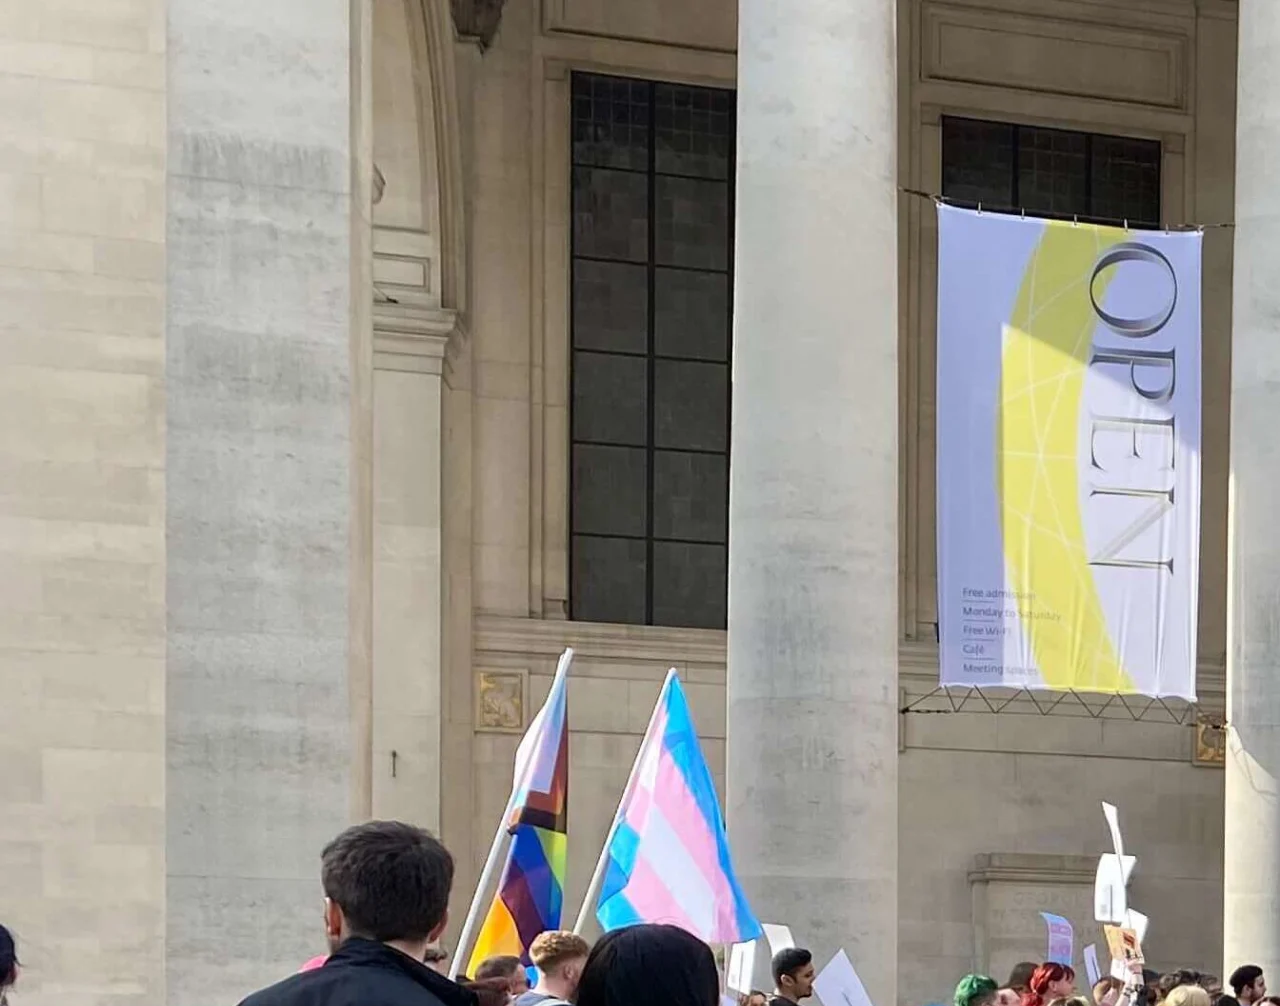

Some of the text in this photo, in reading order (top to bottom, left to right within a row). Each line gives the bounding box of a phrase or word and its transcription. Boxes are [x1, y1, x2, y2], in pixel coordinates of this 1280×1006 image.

[1087, 242, 1177, 576] OPEN
[962, 587, 984, 598] Free
[963, 607, 1002, 618] Monday
[963, 625, 984, 634] Free
[963, 663, 1003, 676] Meeting
